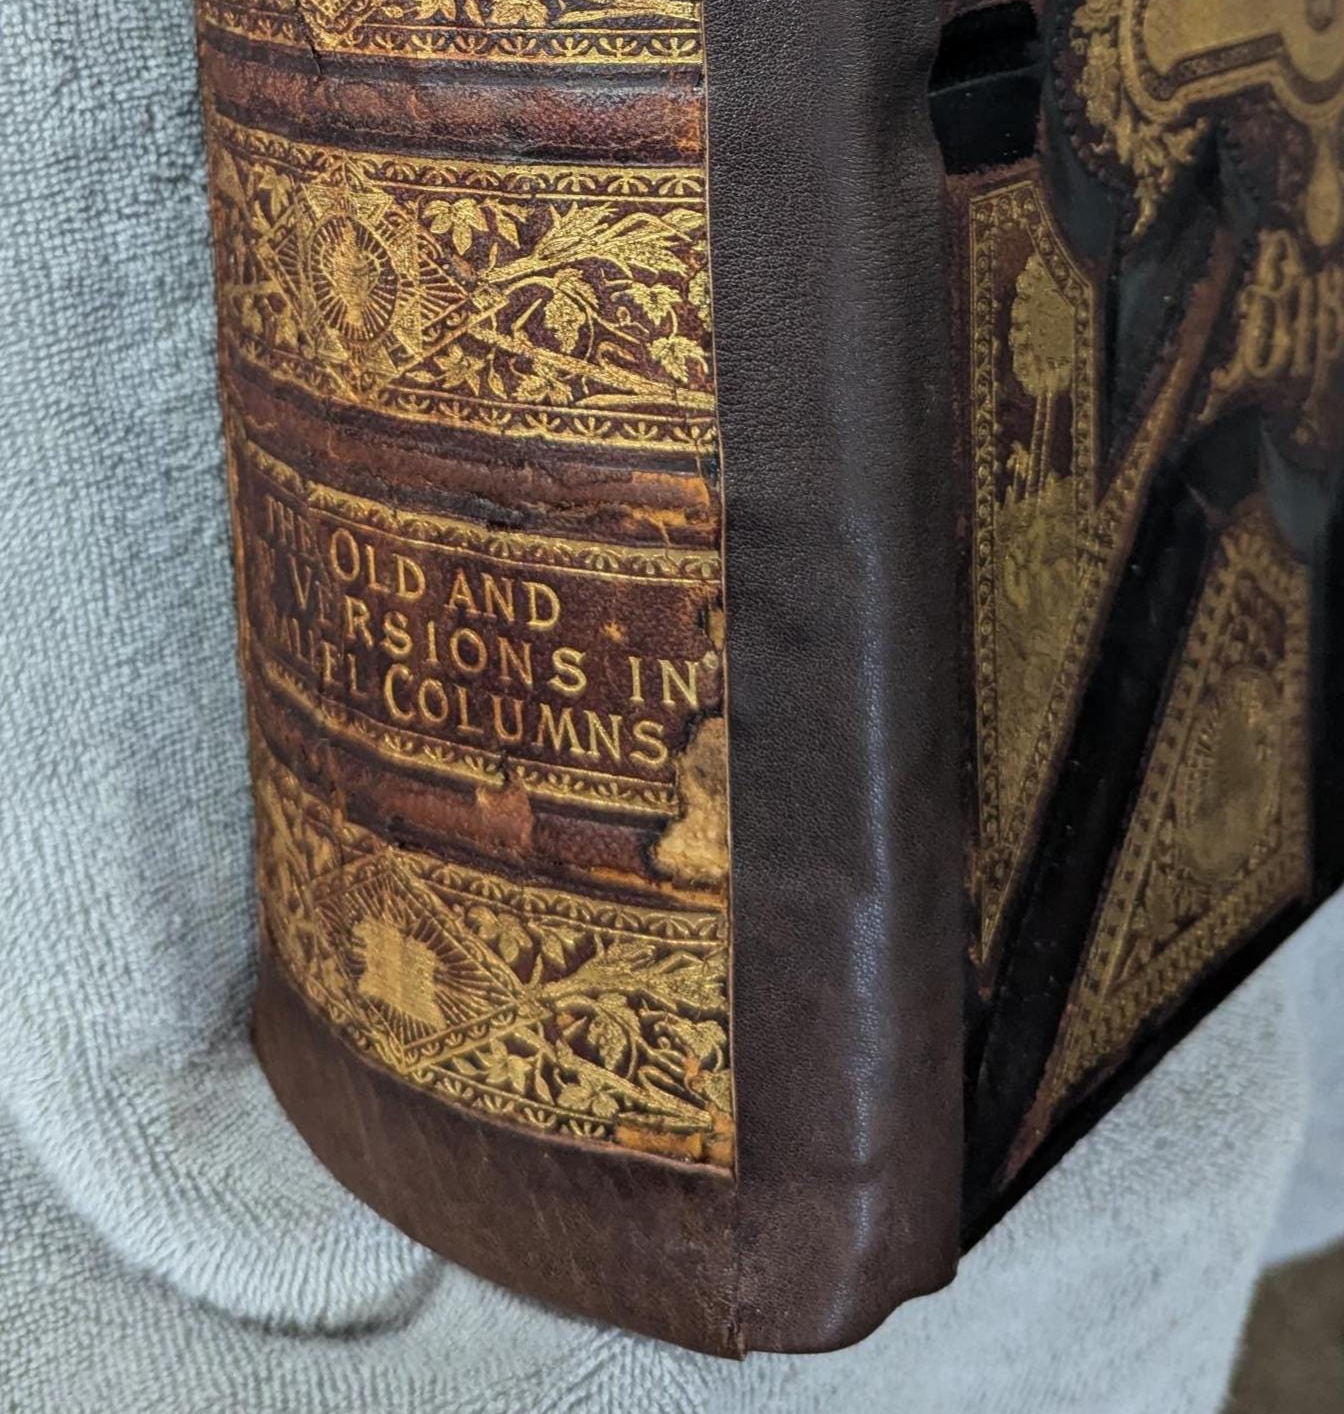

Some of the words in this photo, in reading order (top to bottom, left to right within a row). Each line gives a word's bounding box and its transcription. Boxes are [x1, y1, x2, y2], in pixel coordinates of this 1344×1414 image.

[288, 554, 587, 692] VERSIONS
[628, 656, 700, 709] IN
[329, 527, 426, 602] OLD
[443, 568, 561, 632] AND
[383, 662, 669, 771] COLUMNS
